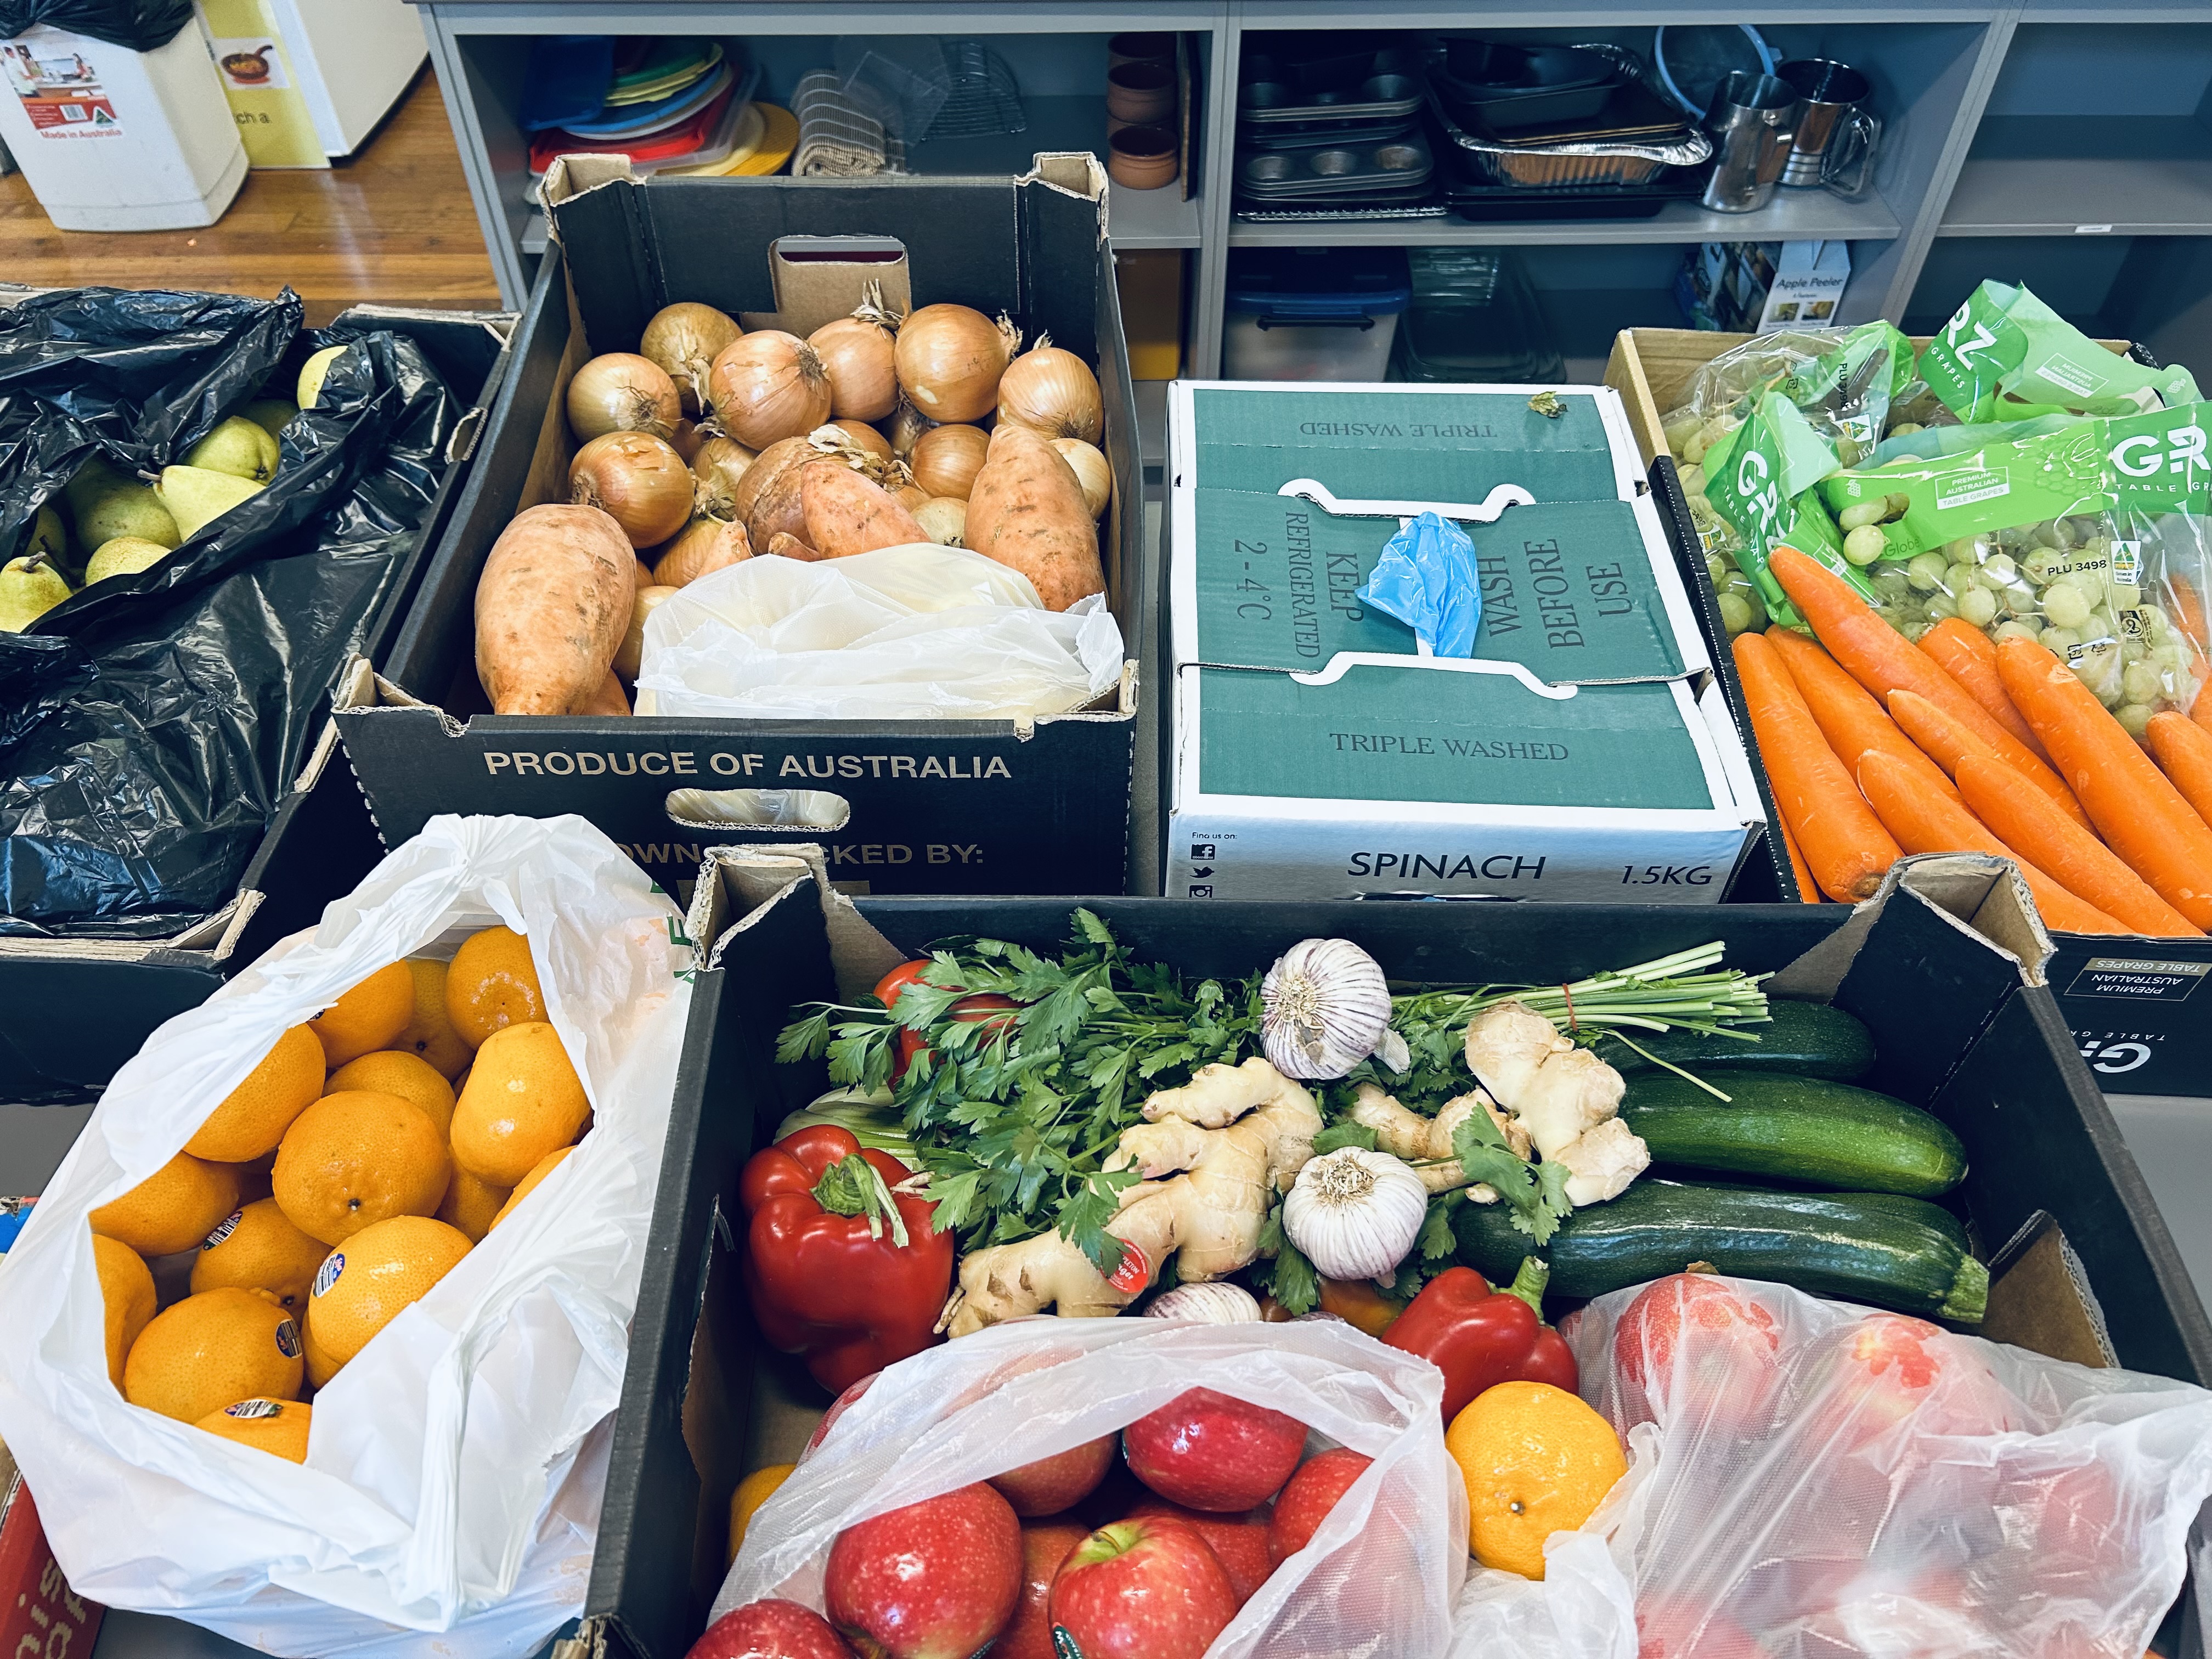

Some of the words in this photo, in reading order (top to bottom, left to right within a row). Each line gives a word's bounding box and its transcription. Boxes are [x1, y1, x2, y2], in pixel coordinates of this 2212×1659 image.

[1776, 278, 1808, 290] Apple
[1810, 276, 1843, 287] Peeler
[1839, 363, 1848, 381] PLU
[1931, 346, 1965, 389] GRAPES
[1300, 422, 1402, 436] WASHED
[1412, 423, 1497, 438] TRIPLE
[1945, 477, 1999, 495] AUSTRALIAN
[1951, 472, 1992, 486] PREMIUM
[2115, 483, 2176, 492] TABLE
[2192, 482, 2211, 492] GR
[1724, 485, 1745, 523] TABLE
[1943, 497, 1968, 506] TABLE
[1970, 487, 2004, 500] GRAPES
[1234, 539, 1267, 554] 2
[1884, 538, 1920, 557] Globe
[2047, 563, 2072, 576] PLU
[2075, 560, 2107, 571] 3498
[1285, 511, 1321, 658] REFRIGERATED
[1326, 551, 1364, 622] KEEP
[1587, 562, 1633, 617] USE
[1477, 555, 1522, 636] WASH
[1523, 539, 1585, 650] BEFORE
[1329, 733, 1435, 755] TRIPLE
[1441, 737, 1569, 760] WASHED
[483, 751, 698, 776] PRODUCE
[709, 752, 764, 775] OF
[778, 755, 1012, 778] AUSTRALIA
[927, 844, 984, 865] BY:
[1347, 851, 1546, 880] SPINACH
[1621, 864, 1713, 886] 1.5KG
[2095, 960, 2153, 970] GRAPES
[2156, 962, 2201, 973] TABLE
[2091, 974, 2183, 985] AUSTRALIAN
[2096, 984, 2165, 994] PREMIUM
[2104, 1032, 2166, 1041] TABLE
[1122, 1255, 1140, 1274] PLETON
